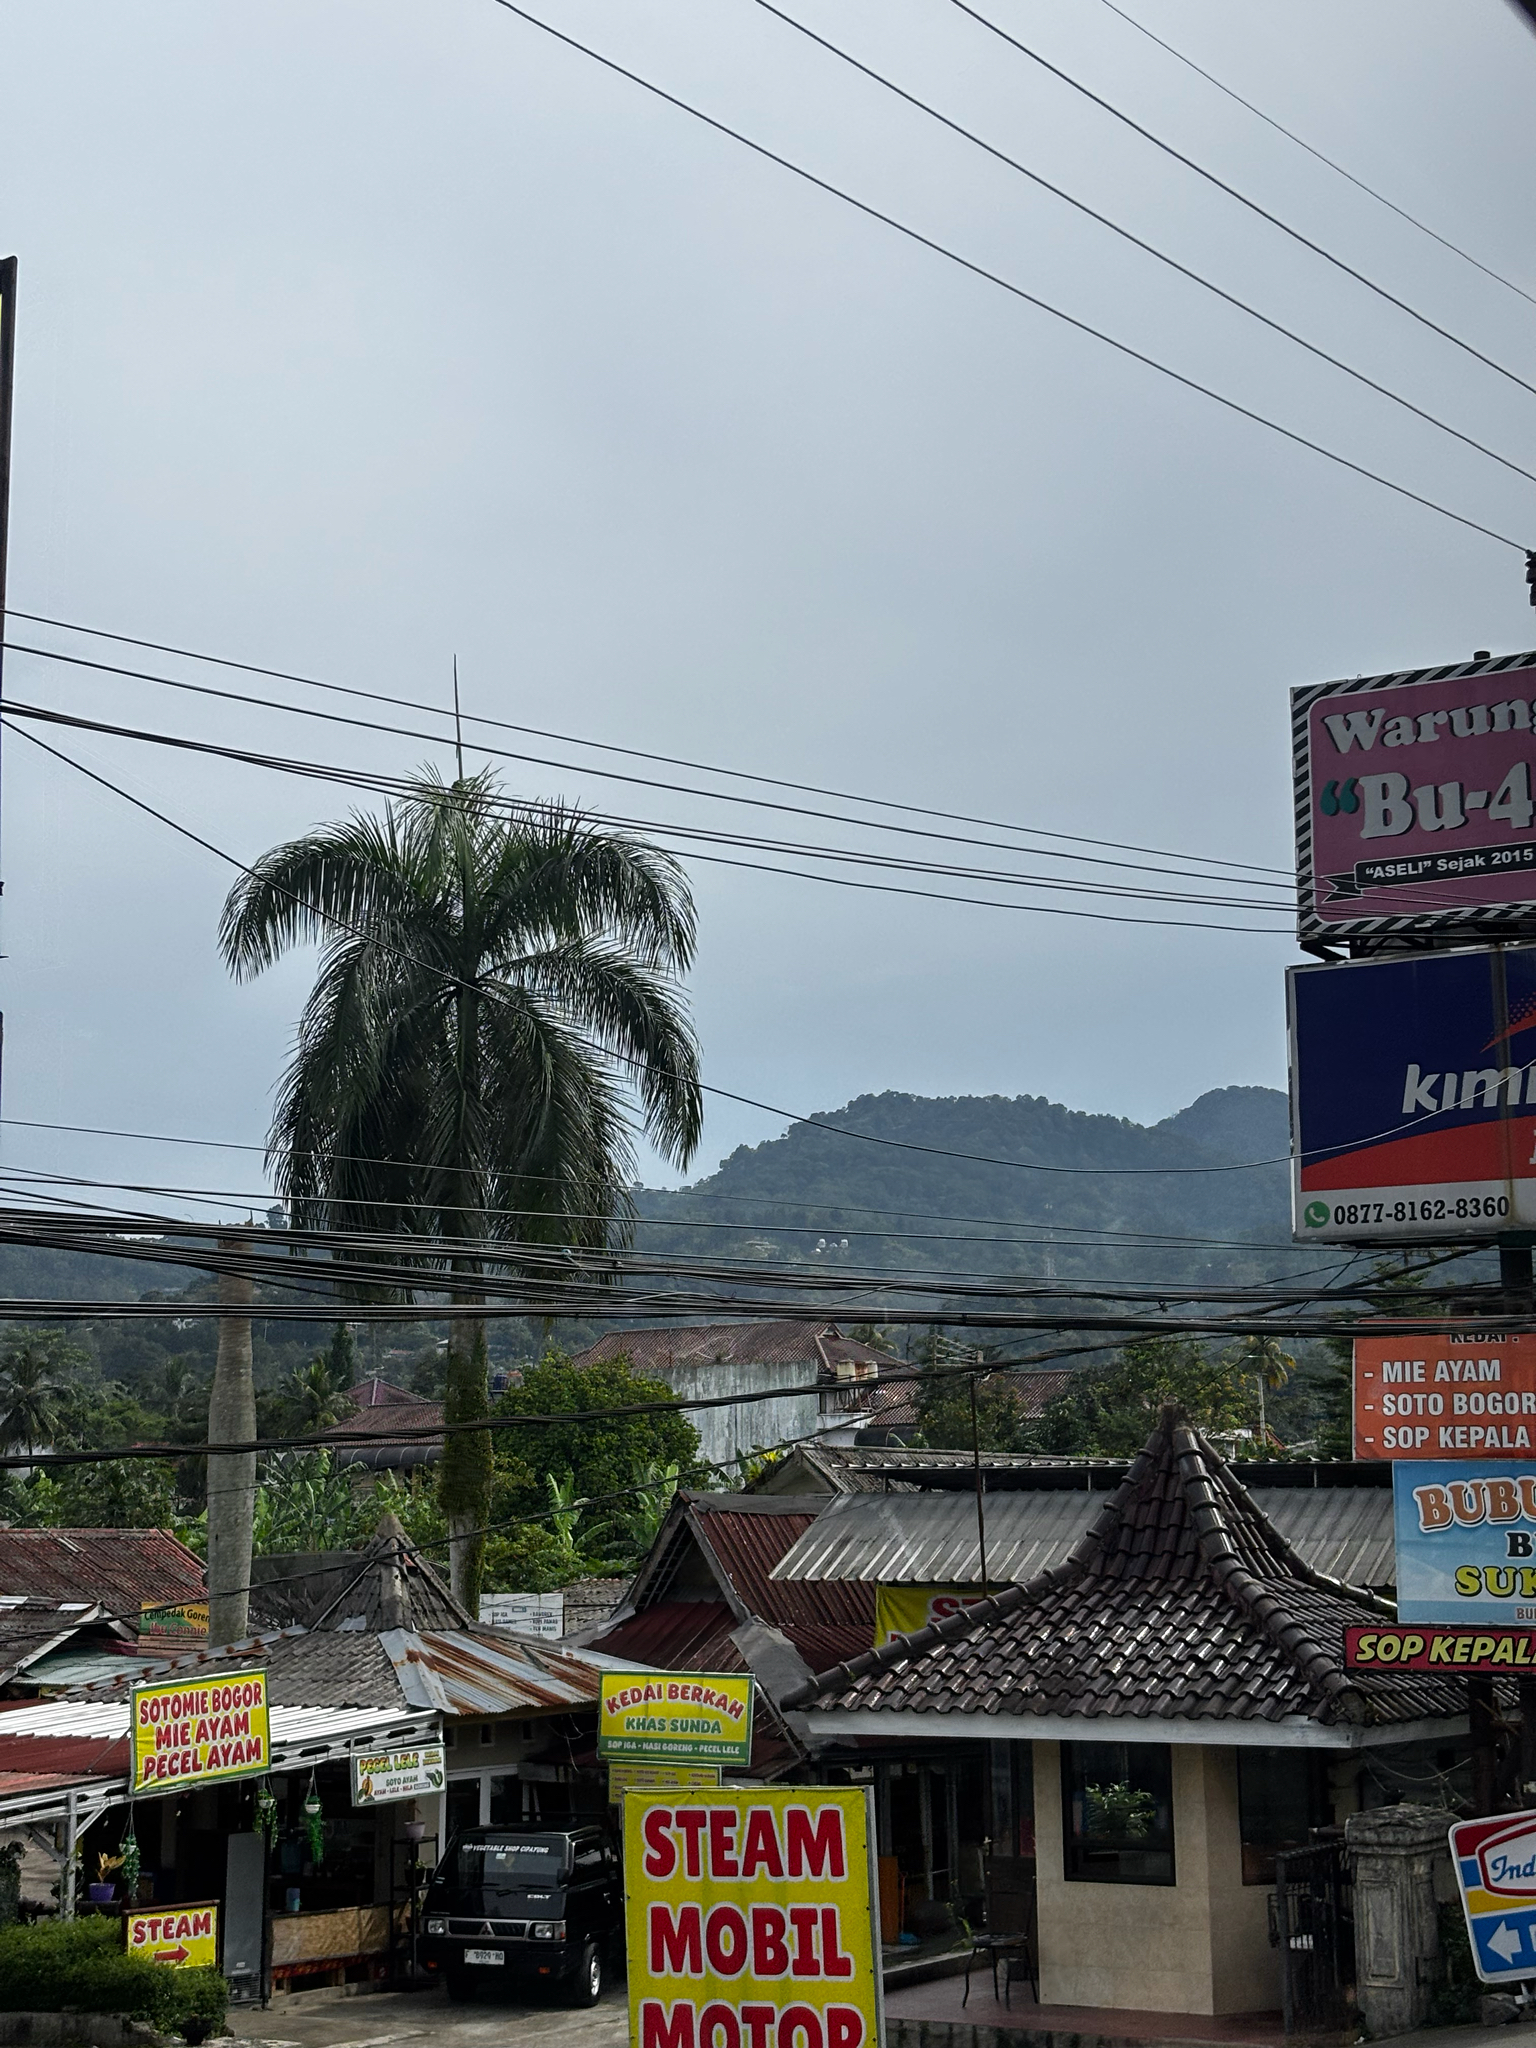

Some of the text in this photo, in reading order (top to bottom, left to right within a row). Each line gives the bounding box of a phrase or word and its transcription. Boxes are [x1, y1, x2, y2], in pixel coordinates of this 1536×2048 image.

[1322, 698, 1536, 754] Warun
[1436, 854, 1486, 872] Sejak
[1490, 848, 1534, 866] 2015
[1333, 1196, 1510, 1225] 0877-8162-8360
[1382, 1361, 1426, 1383] MIE
[1434, 1359, 1501, 1382] AYAM
[1382, 1392, 1444, 1416] SOTO
[1453, 1392, 1536, 1415] BOGOR
[1382, 1426, 1430, 1449] SOP
[1438, 1425, 1531, 1448] KEPALA
[169, 1622, 207, 1636] Connie
[1355, 1634, 1536, 1665] SOP KEPAL
[139, 1682, 263, 1725] SOTOMIE BOGOR
[604, 1683, 745, 1720] KEDAI BERKAH
[155, 1711, 250, 1751] MIE AYAM
[625, 1716, 722, 1734] KHAS SUNDA
[143, 1736, 262, 1781] PECEL AYAM
[360, 1755, 393, 1776] PECEL
[394, 1752, 420, 1770] LELE
[643, 1807, 846, 1879] STEAM
[132, 1911, 212, 1944] STEAM
[649, 1904, 853, 1978] MOBIL
